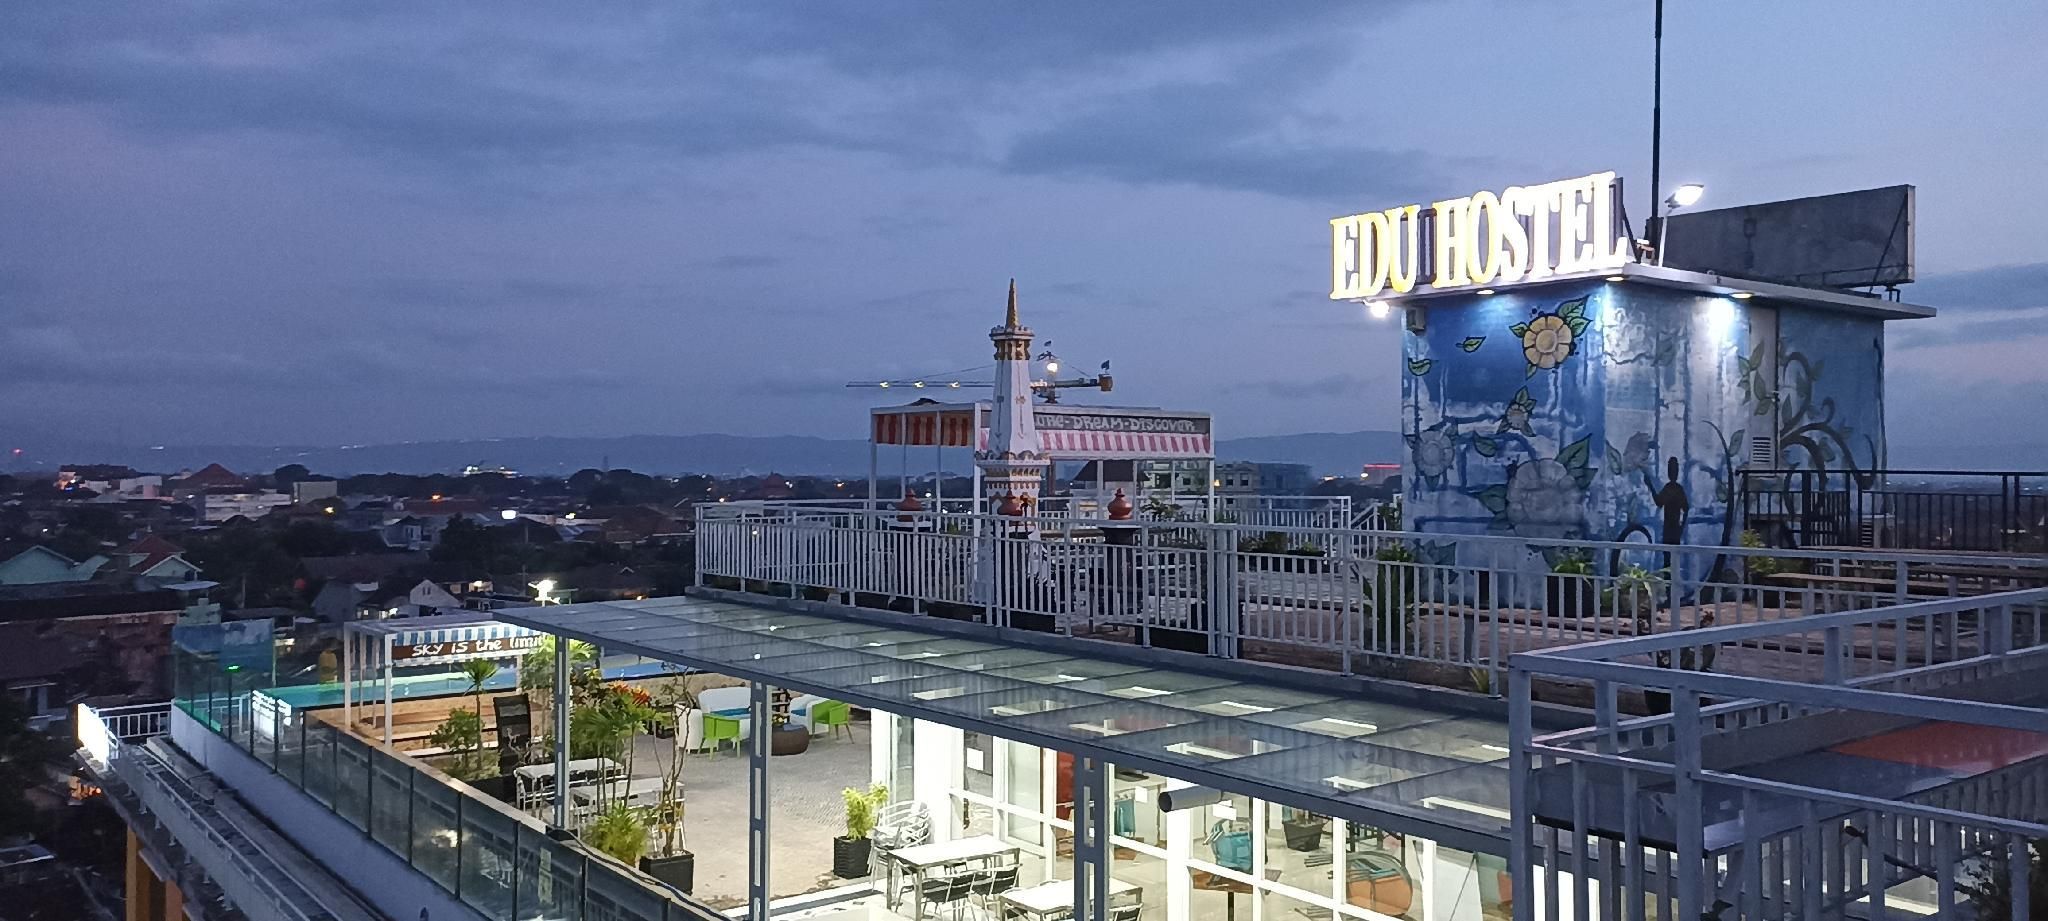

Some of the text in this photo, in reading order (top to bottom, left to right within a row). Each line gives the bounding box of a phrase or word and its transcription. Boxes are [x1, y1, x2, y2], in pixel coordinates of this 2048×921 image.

[1329, 170, 1628, 300] EDU HOSTEL
[411, 643, 444, 657] SKY
[475, 637, 503, 652] the
